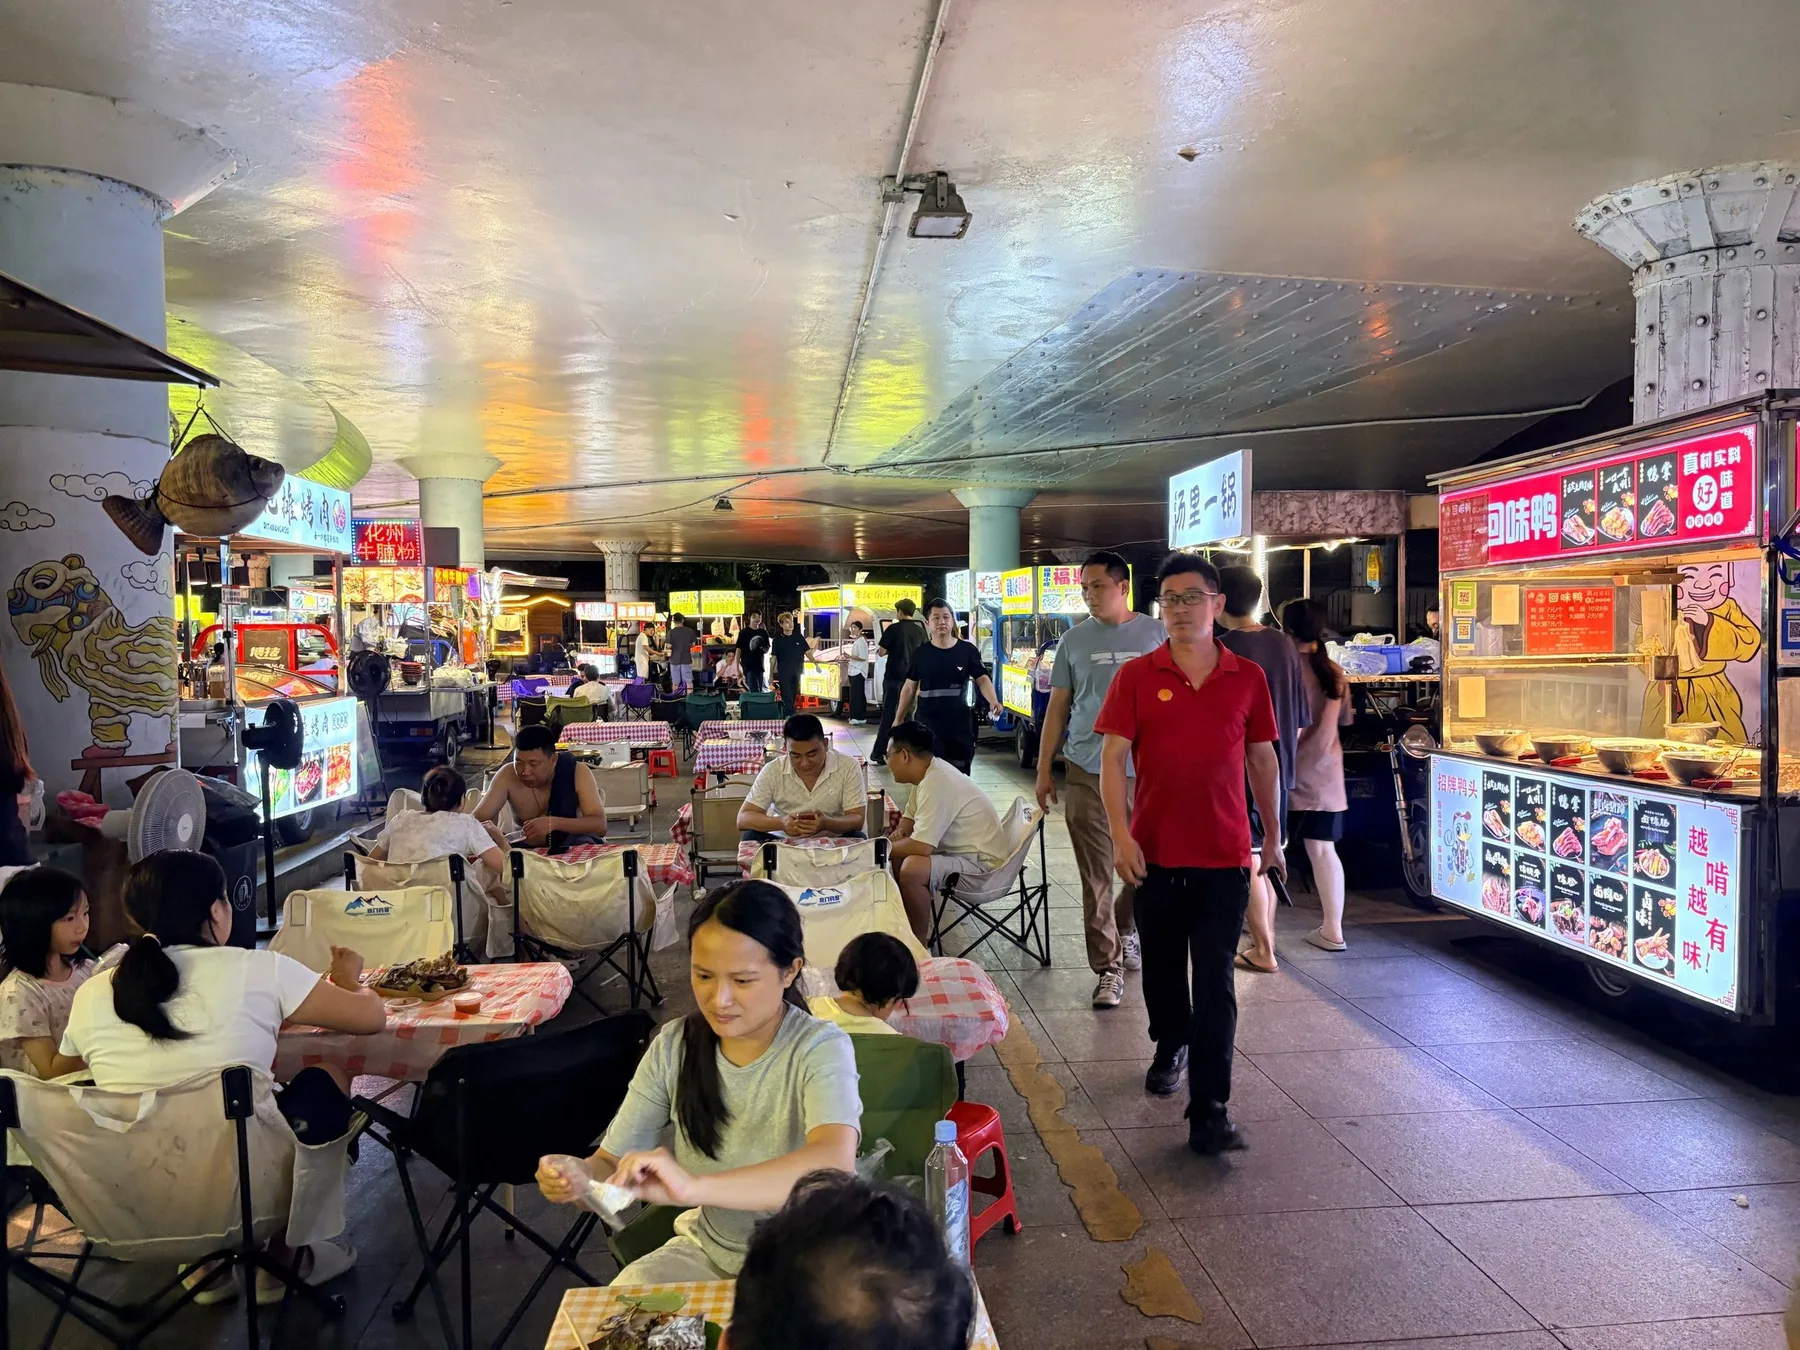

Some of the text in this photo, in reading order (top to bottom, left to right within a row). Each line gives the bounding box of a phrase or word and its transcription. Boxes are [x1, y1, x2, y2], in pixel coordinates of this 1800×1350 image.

[1683, 445, 1742, 476] 真材实料
[1173, 470, 1237, 531] 汤里一锅
[1696, 481, 1714, 505] 好
[1488, 492, 1557, 547] 回味鸭
[365, 524, 406, 543] 化州
[356, 541, 416, 561] 牛腩粉
[1437, 773, 1478, 799] 招牌鸭头
